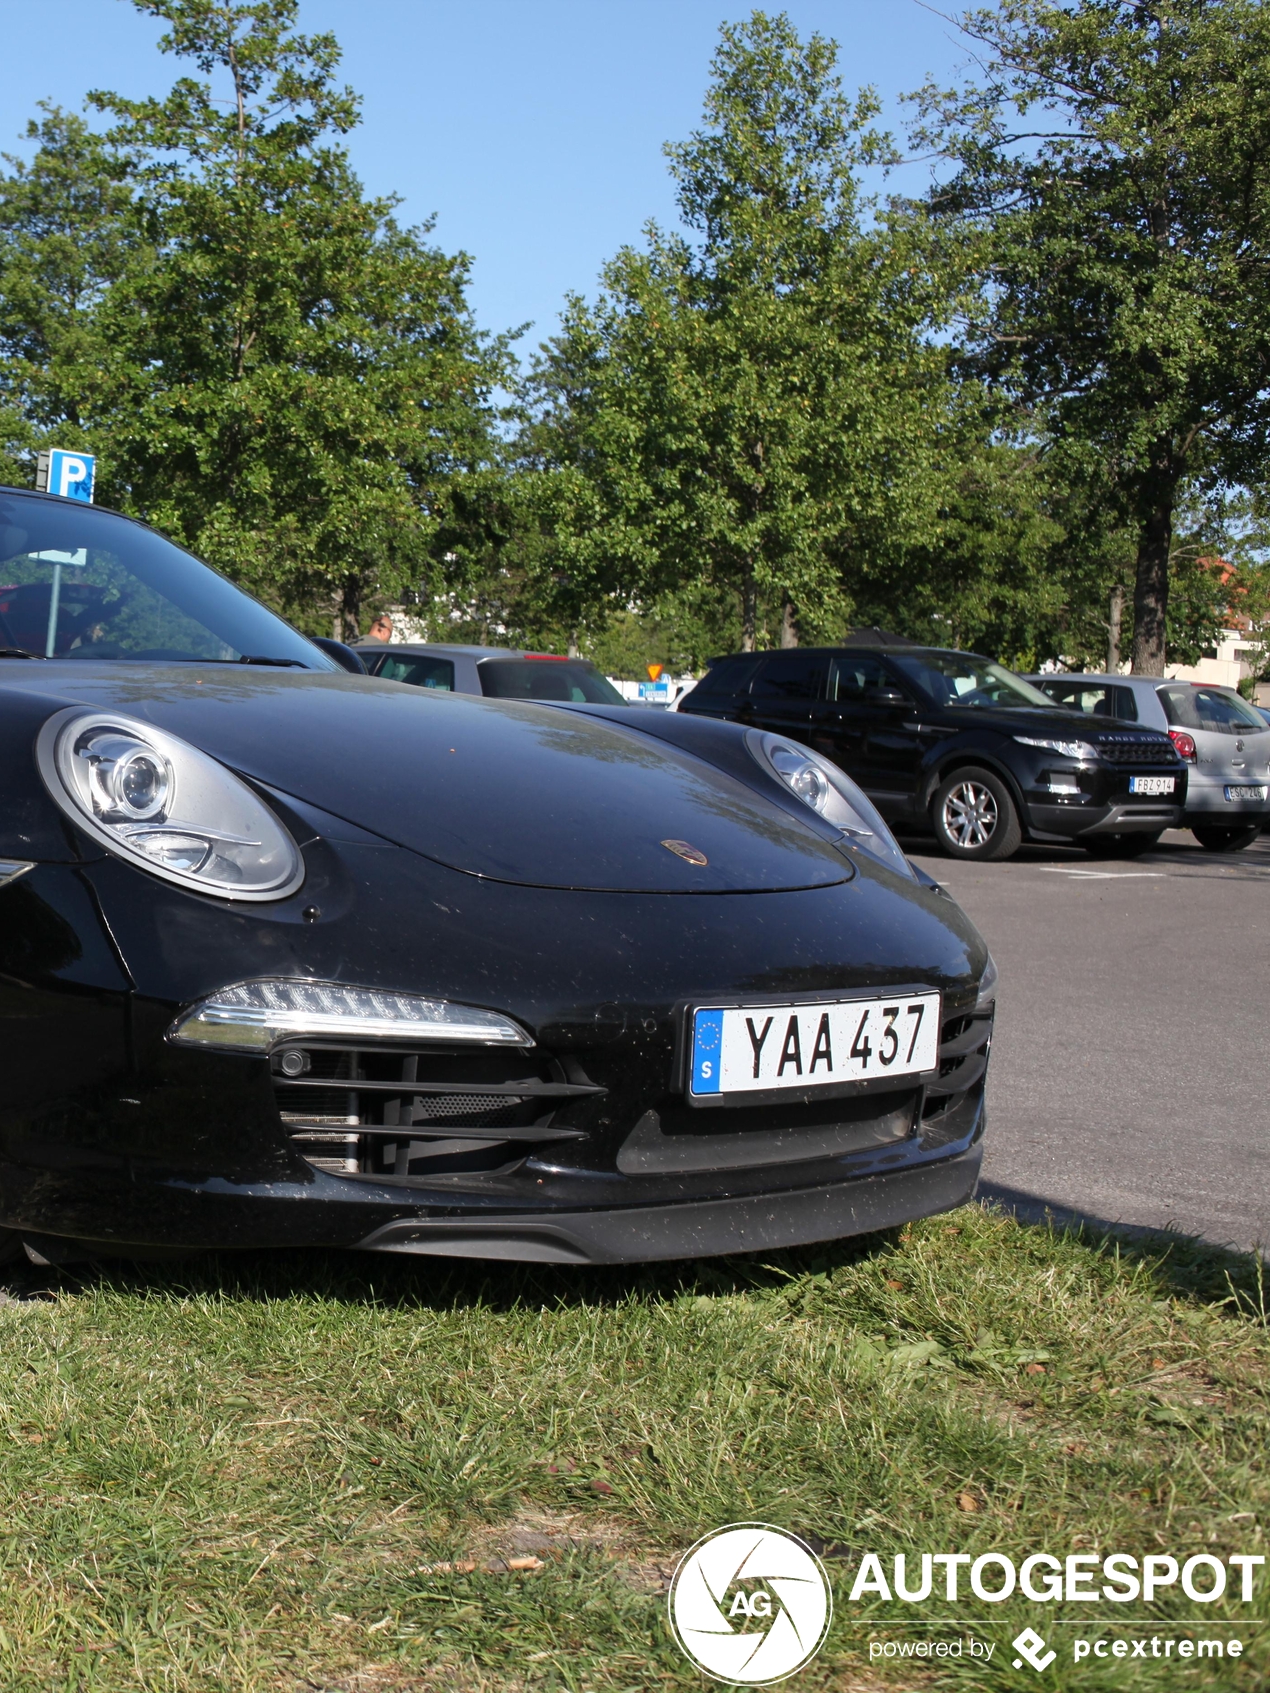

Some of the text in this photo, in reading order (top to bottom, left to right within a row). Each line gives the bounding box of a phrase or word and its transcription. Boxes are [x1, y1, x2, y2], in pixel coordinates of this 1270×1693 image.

[59, 456, 87, 497] P
[1137, 779, 1171, 791] FBZ 914
[1230, 787, 1245, 798] ESC
[745, 1004, 925, 1079] YAA 437
[701, 1061, 712, 1078] S
